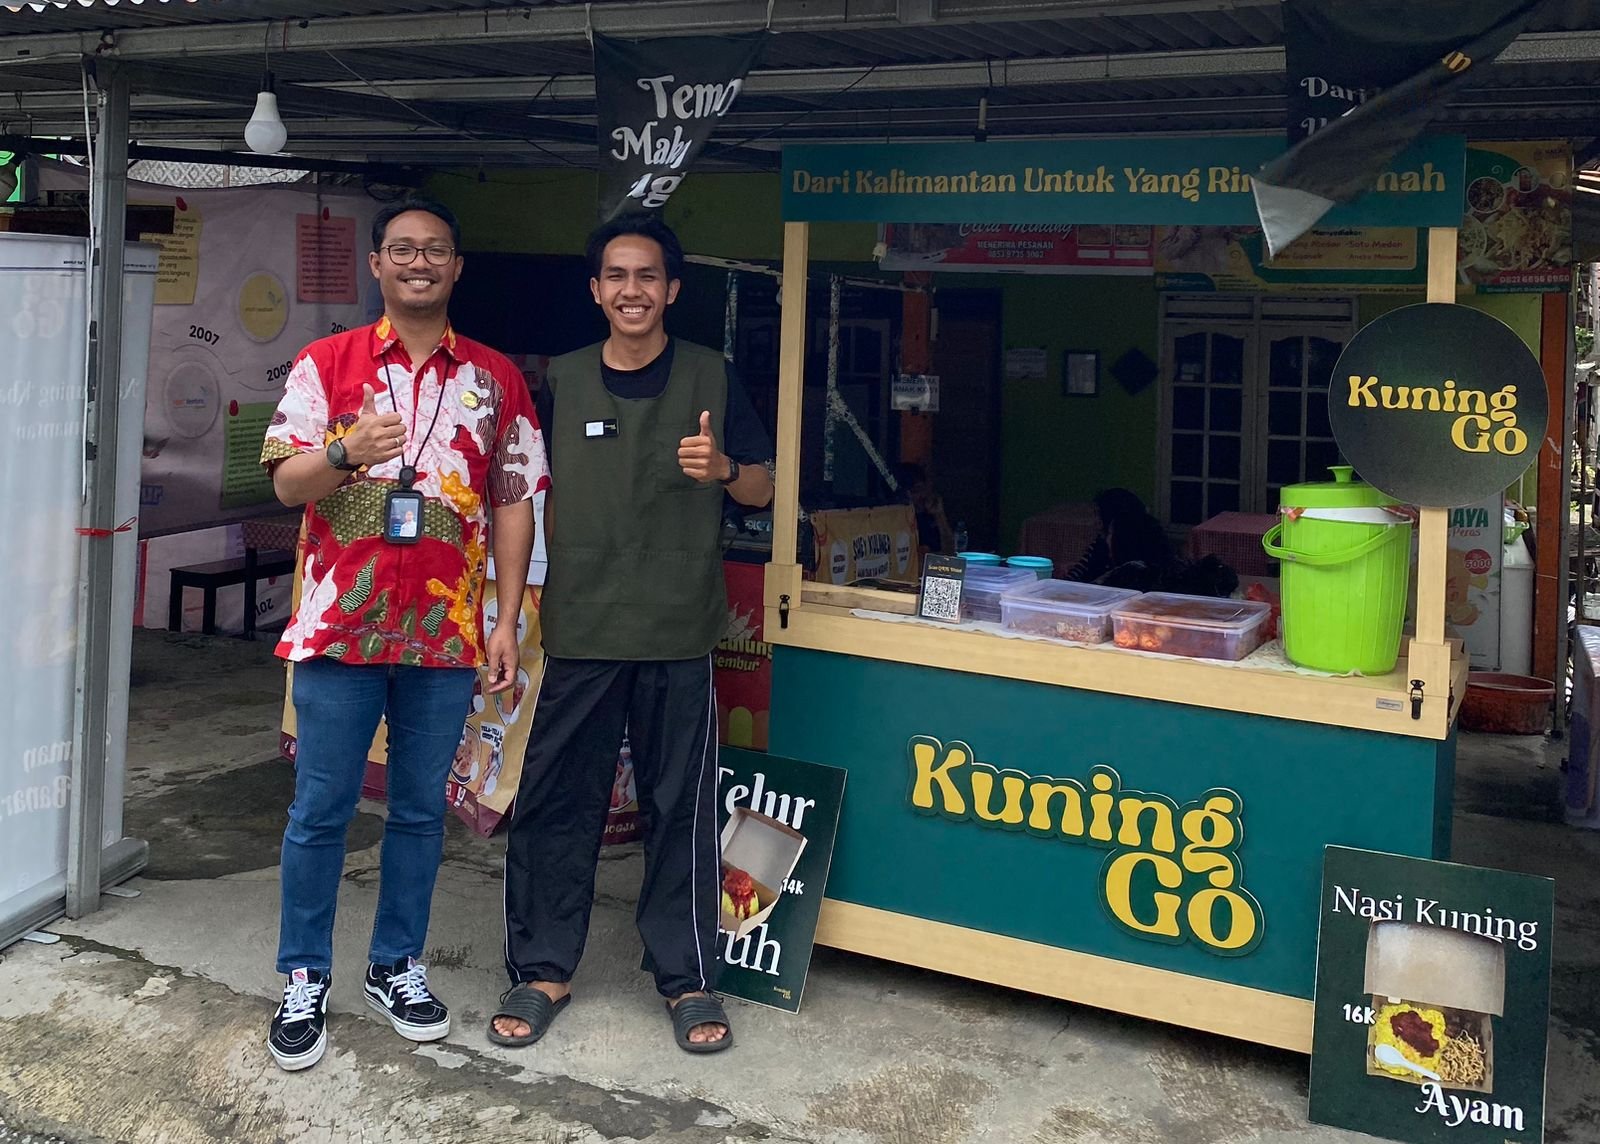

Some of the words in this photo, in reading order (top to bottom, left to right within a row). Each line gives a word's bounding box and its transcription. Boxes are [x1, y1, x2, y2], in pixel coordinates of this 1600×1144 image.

[1300, 76, 1365, 104] Dari
[792, 170, 849, 193] Dari
[855, 168, 1016, 193] Kalimantan
[1023, 165, 1114, 193] Untuk
[1124, 167, 1199, 201] Yang
[1376, 163, 1446, 193] nah
[1017, 240, 1055, 249] PESANAN
[189, 325, 220, 346] 2007
[266, 360, 294, 382] 2009
[1347, 375, 1518, 427] Kuning
[1451, 414, 1528, 455] Go
[1448, 508, 1489, 528] AYA
[603, 820, 637, 835] JOGJA
[912, 743, 1235, 888] Kuning
[782, 877, 804, 895] 14K
[1105, 851, 1257, 949] Go
[1332, 885, 1402, 921] Nasi
[1415, 897, 1538, 951] Kuning
[1343, 1003, 1376, 1025] 16K
[1415, 1082, 1526, 1131] Ayam
